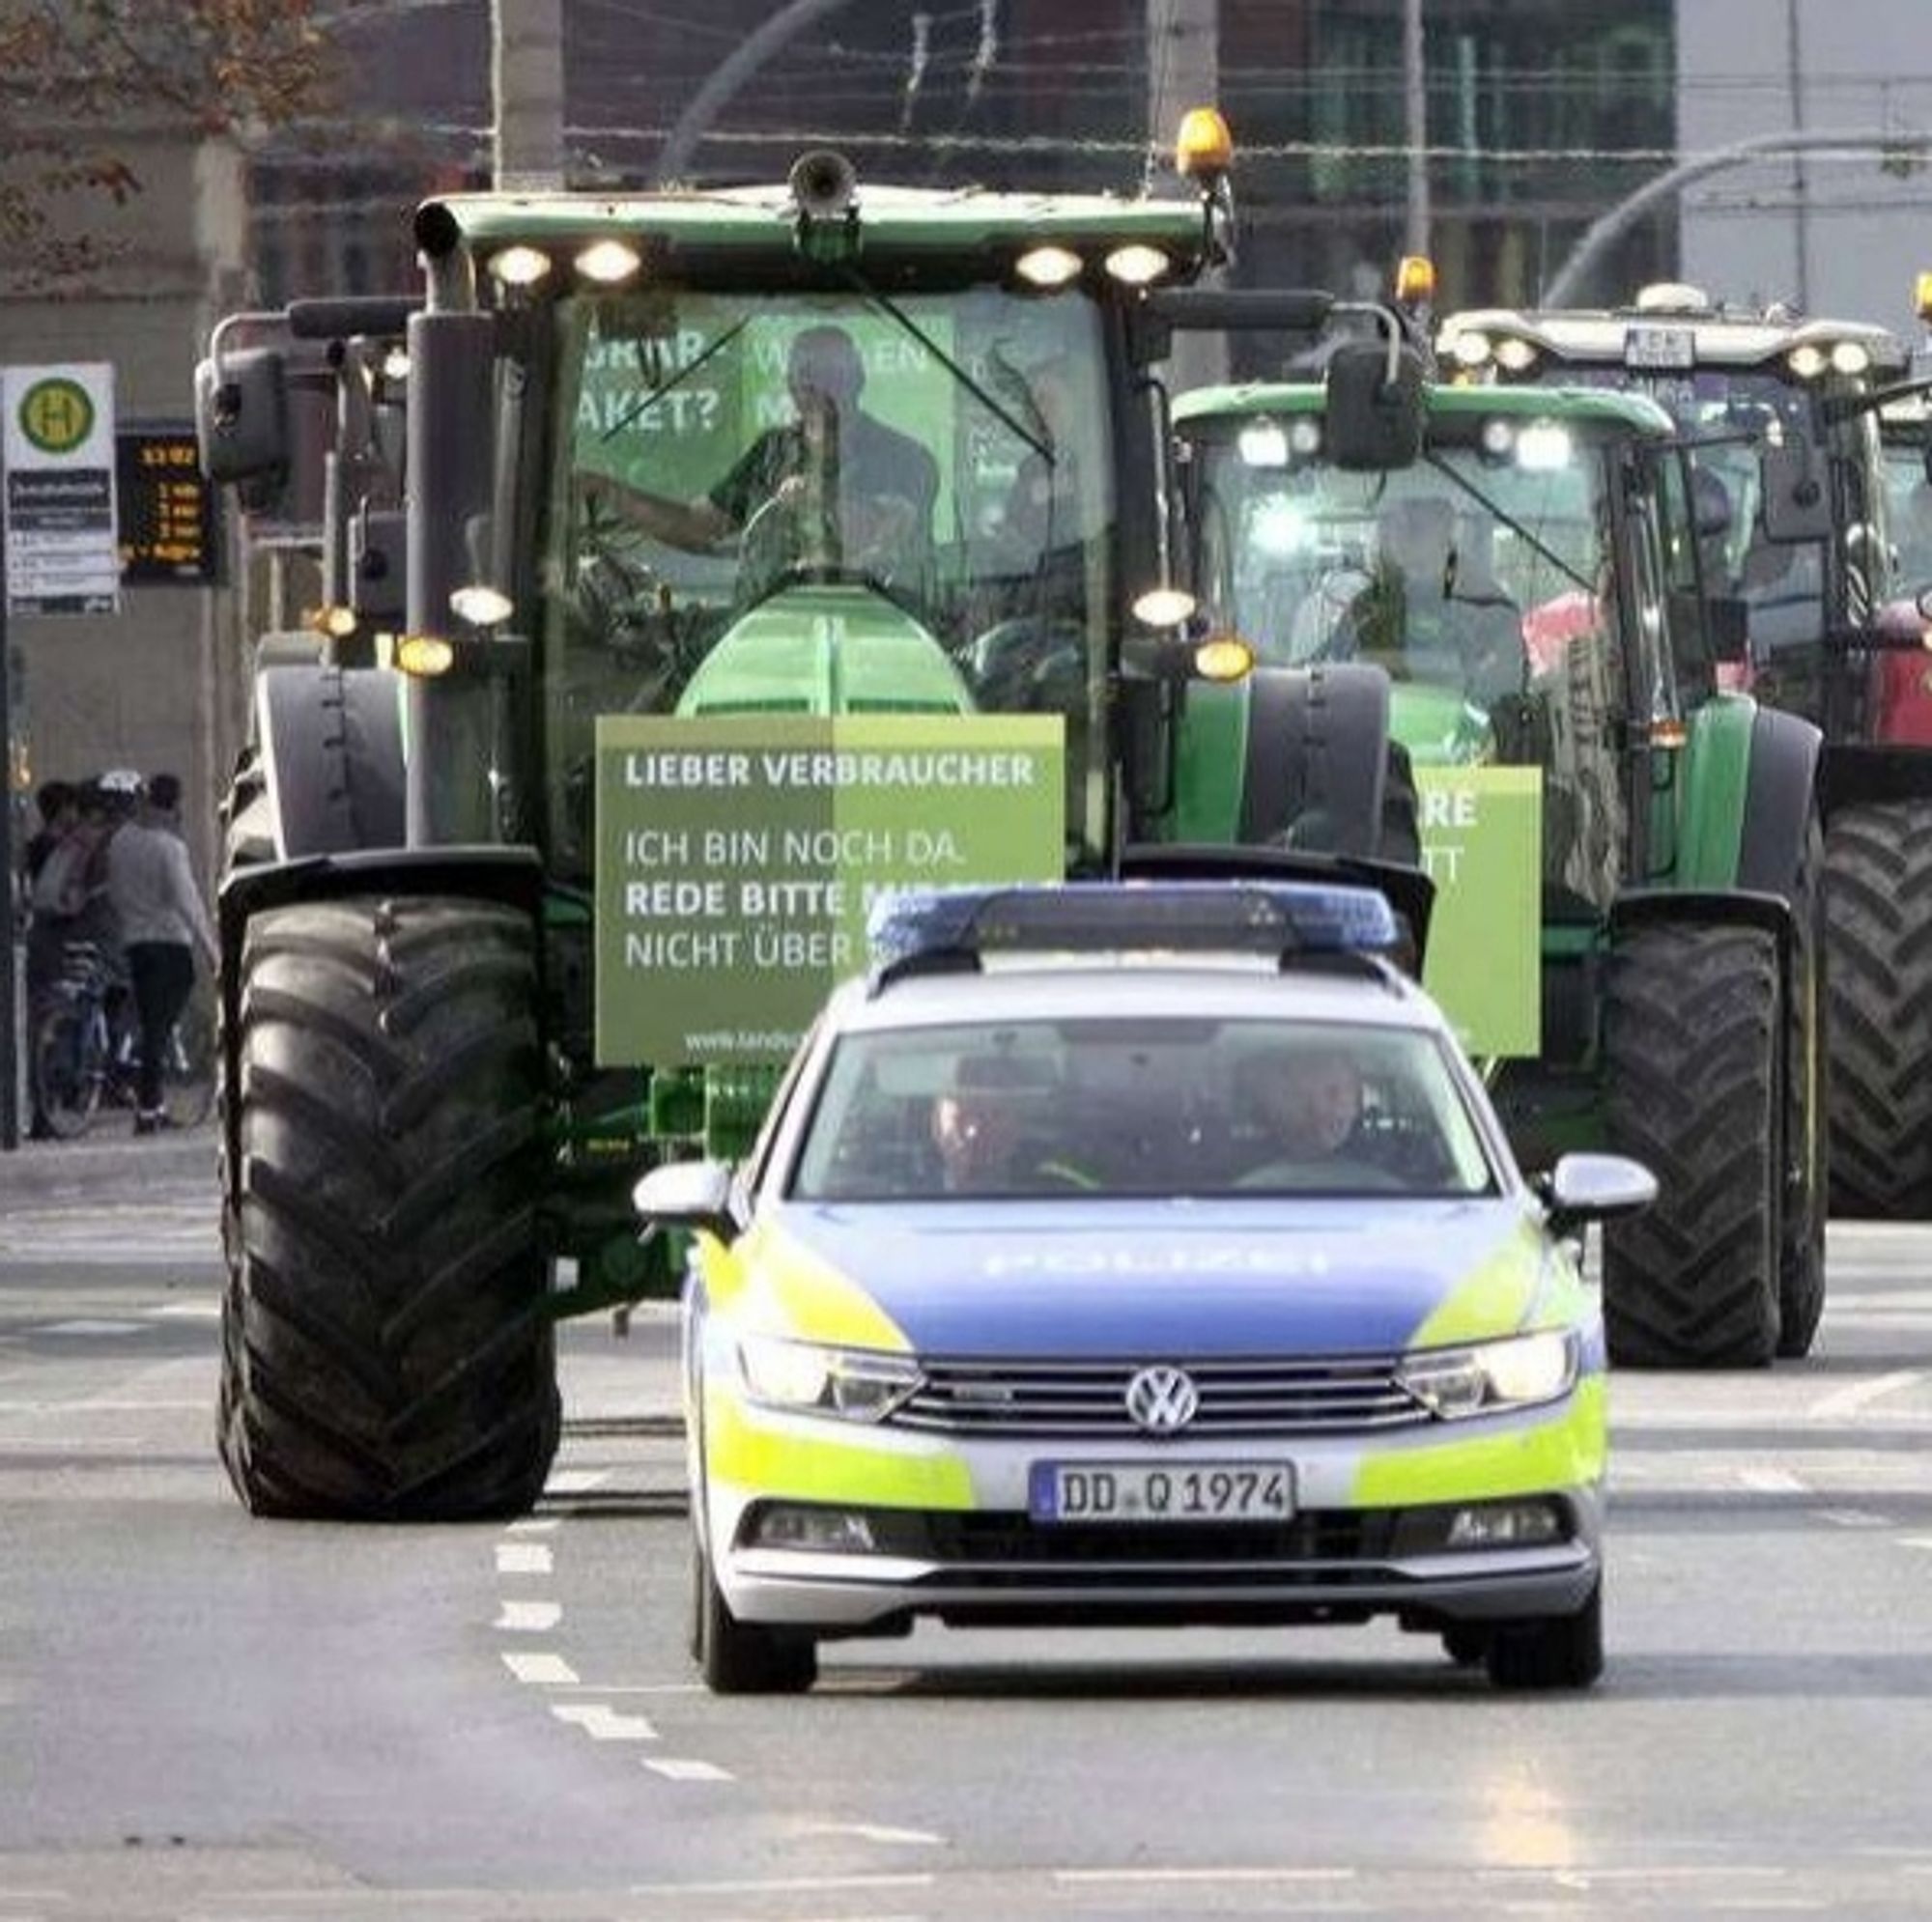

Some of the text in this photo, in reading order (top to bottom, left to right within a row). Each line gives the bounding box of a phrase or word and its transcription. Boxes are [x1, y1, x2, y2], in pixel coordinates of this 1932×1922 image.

[577, 388, 720, 431] AKET?
[625, 753, 1035, 786] LIEBER VERBRAUCHER
[1417, 791, 1478, 827] RE
[626, 831, 688, 864] ICH
[704, 831, 766, 864] BIN
[784, 831, 893, 864] NOCH
[626, 881, 725, 915] REDE
[741, 881, 844, 915] BITTE
[626, 920, 851, 965] NICHT ÜBER
[1064, 1473, 1284, 1512] DD Q 1974
